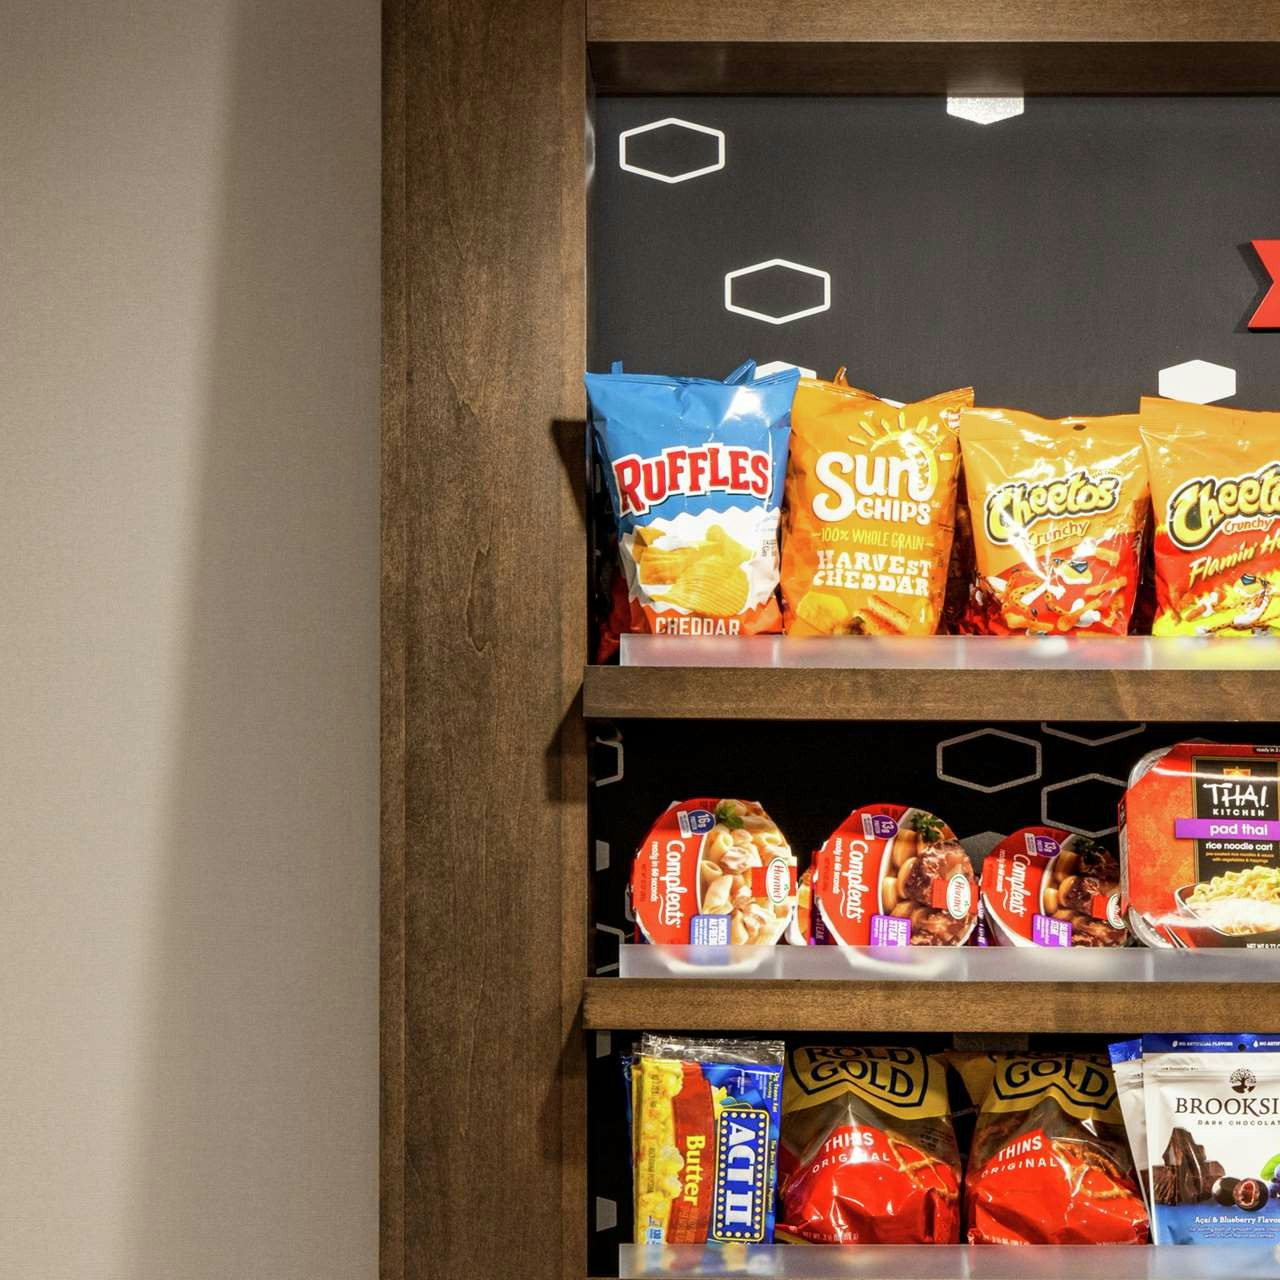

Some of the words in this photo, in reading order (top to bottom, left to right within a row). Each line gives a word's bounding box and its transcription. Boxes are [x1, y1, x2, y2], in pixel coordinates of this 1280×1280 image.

[613, 445, 771, 514] RUFFLES
[856, 498, 931, 525] CHIPS
[987, 474, 1120, 544] Cheetos
[822, 528, 849, 542] 100%
[852, 530, 888, 546] WHOLE
[892, 534, 924, 549] GRAIN
[1223, 518, 1271, 534] Crunchy
[817, 550, 931, 577] HARVEST
[813, 569, 929, 596] CHEDDAR
[655, 616, 740, 635] CHEDDAR
[1203, 783, 1266, 807] THAI
[1210, 824, 1237, 836] pad
[1242, 825, 1267, 836] thai
[650, 841, 659, 860] ready
[1256, 843, 1273, 851] cart
[659, 840, 687, 928] Compleats
[774, 865, 784, 899] Hormel
[842, 839, 869, 922] Compleats
[1005, 854, 1031, 917] Compleats
[955, 881, 965, 912] Hormel
[812, 1061, 914, 1097] GOLD
[1007, 1059, 1109, 1097] GOLD
[727, 1122, 756, 1185] ACT
[997, 1135, 1042, 1161] THINS
[684, 1136, 706, 1206] Butter
[981, 1157, 1057, 1176] ORIGINAL
[725, 1190, 753, 1226] II
